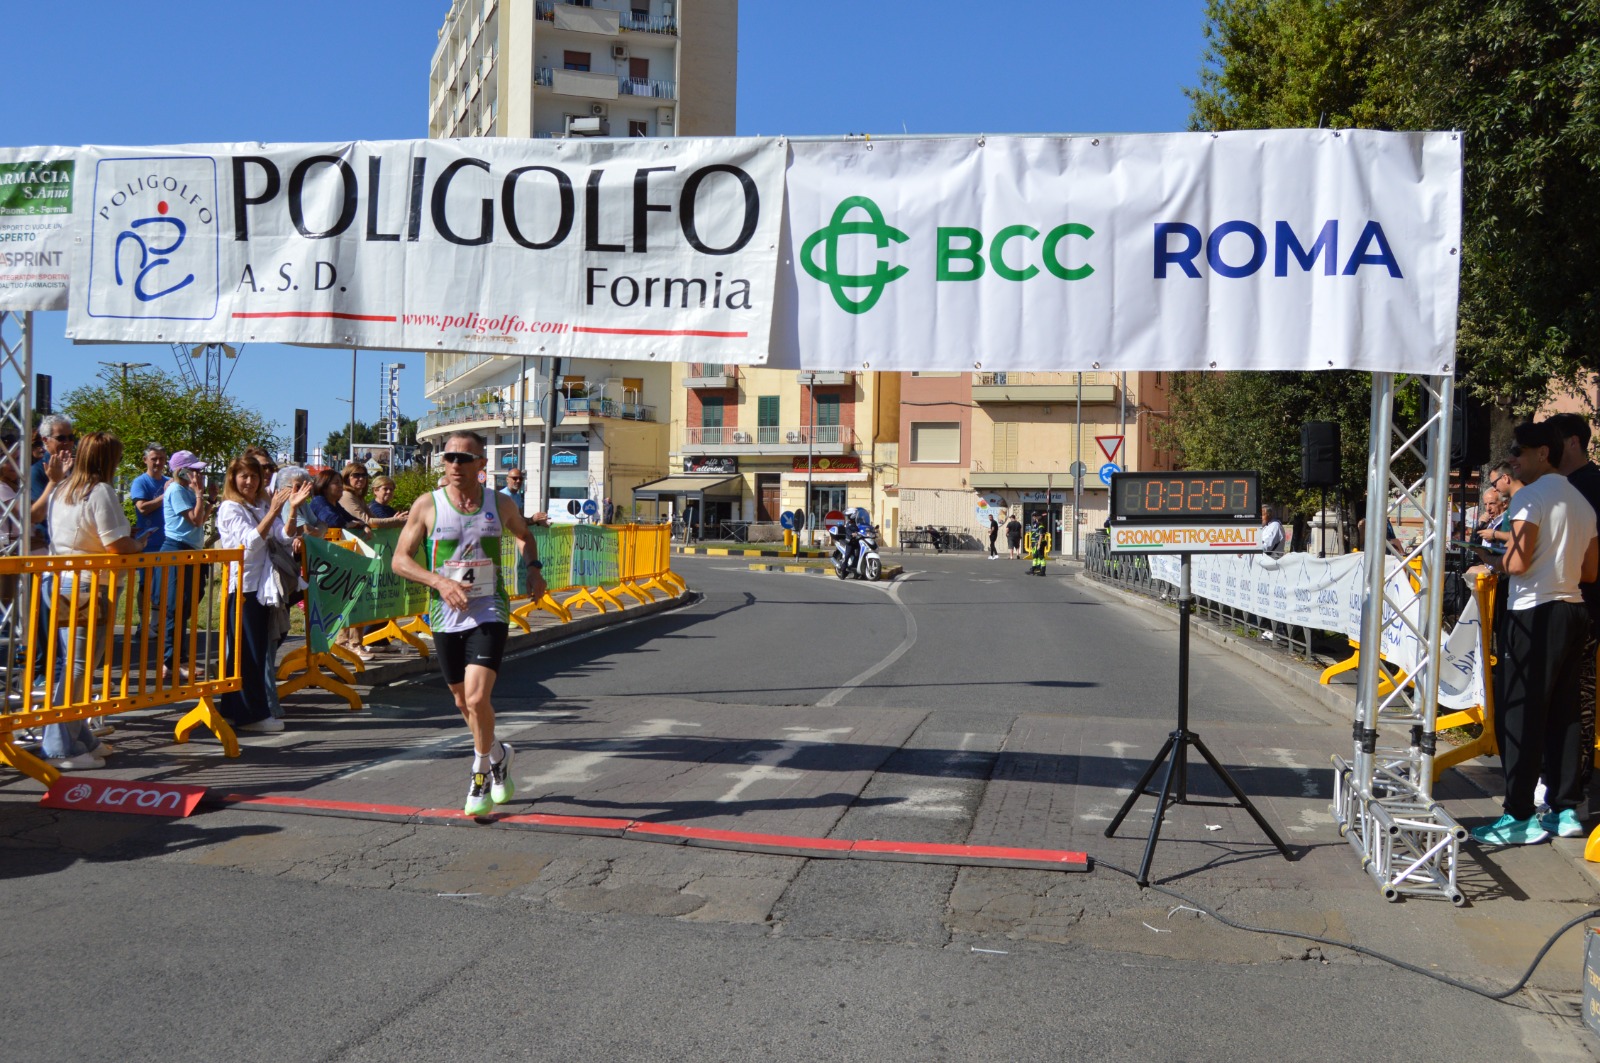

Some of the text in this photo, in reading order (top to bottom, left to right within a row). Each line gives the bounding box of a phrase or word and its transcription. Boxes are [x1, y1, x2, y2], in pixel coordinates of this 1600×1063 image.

[41, 205, 68, 214] Formia
[99, 174, 213, 225] POLIGOLFO
[231, 155, 760, 256] POLIGOLFO
[936, 219, 1404, 282] BCC ROMA
[586, 267, 753, 311] Formia
[402, 313, 569, 335] www.poligolfo.com
[1145, 480, 1248, 511] 0:32:57
[1116, 528, 1258, 545] CRONOMETROGARA.IT
[462, 568, 475, 584] 4
